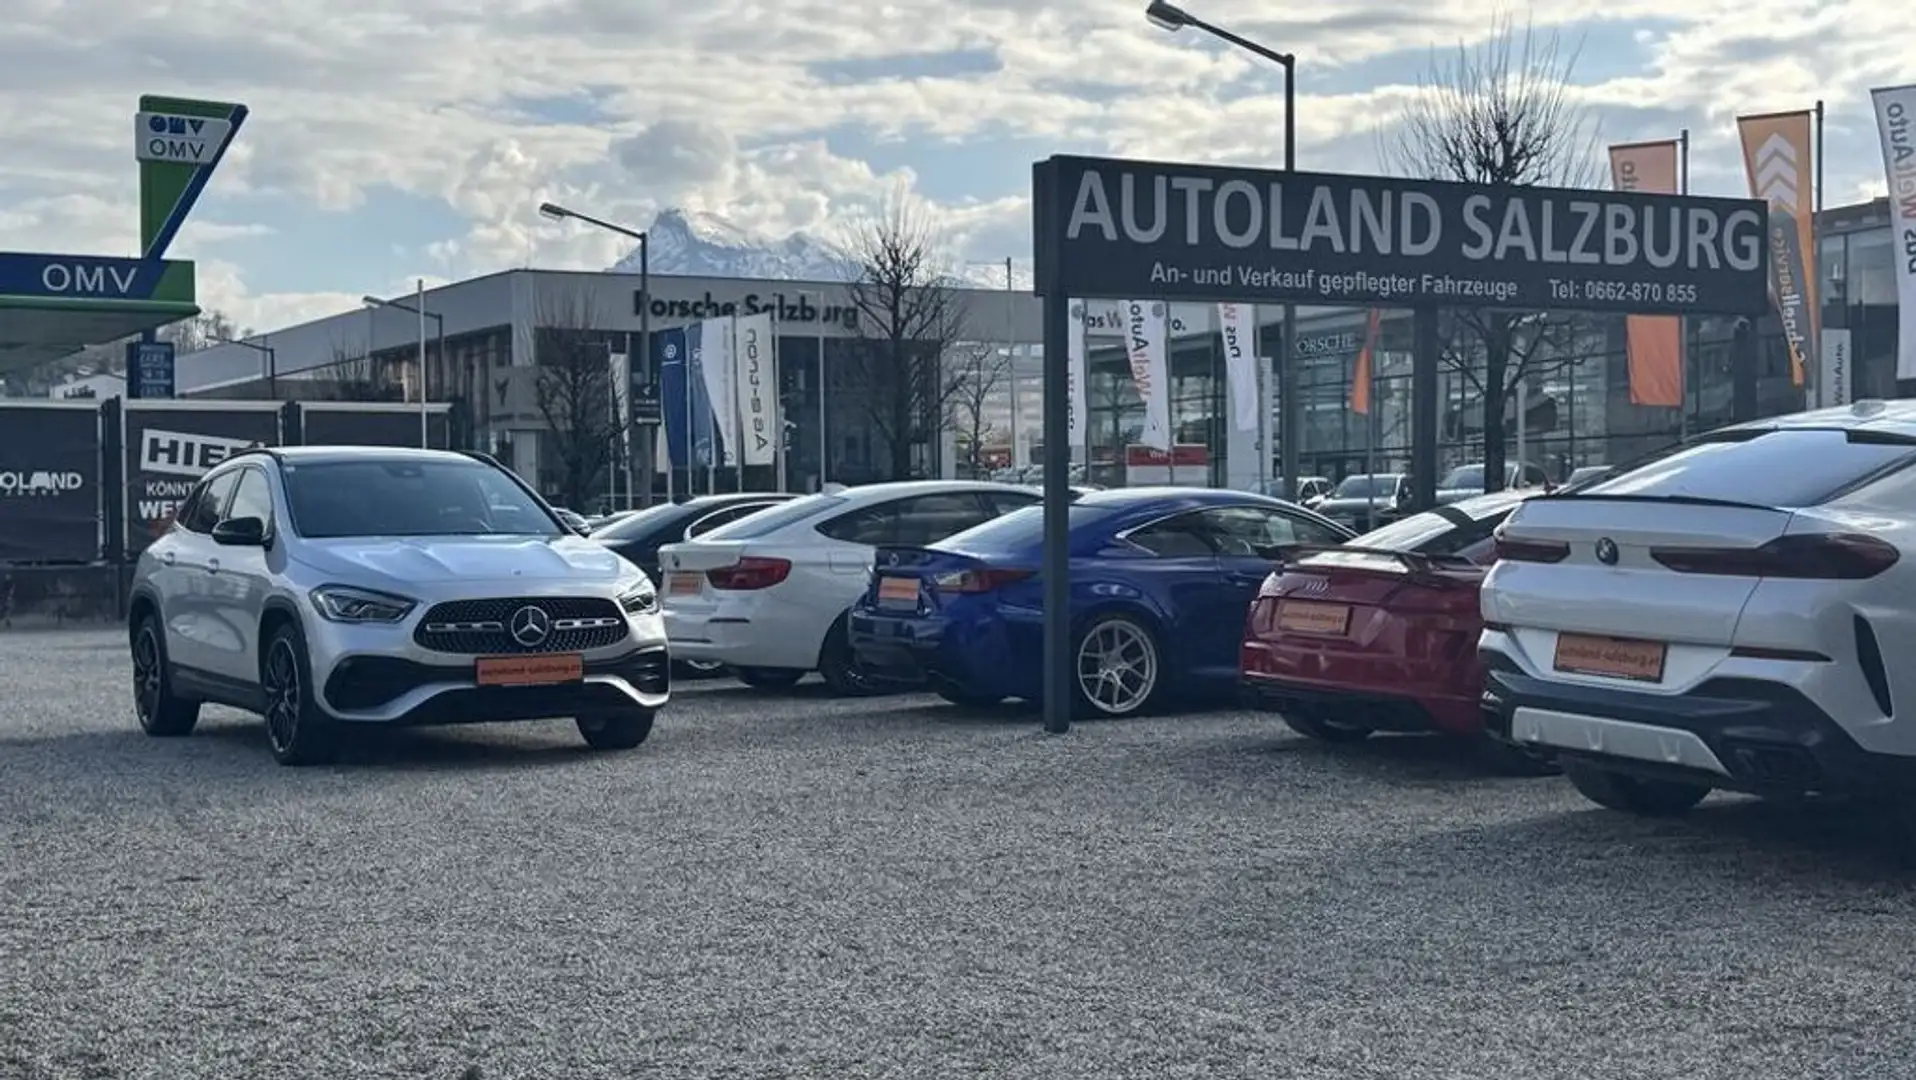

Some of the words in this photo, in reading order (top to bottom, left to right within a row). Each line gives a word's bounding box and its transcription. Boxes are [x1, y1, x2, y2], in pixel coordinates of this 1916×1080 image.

[149, 138, 204, 158] OMV
[1066, 169, 1442, 256] AUTOLAND
[1462, 194, 1759, 271] SALZBURG
[42, 263, 138, 294] OMV
[1151, 262, 1187, 284] An-
[1194, 265, 1231, 285] und
[1238, 265, 1314, 288] Verkauf
[1320, 270, 1415, 296] gepflegter
[1422, 275, 1517, 300] Fahrzeuge
[1550, 279, 1579, 298] Tel:
[1585, 280, 1661, 301] 0662-870
[1666, 283, 1697, 302] 855
[146, 480, 197, 496] KÖNNT
